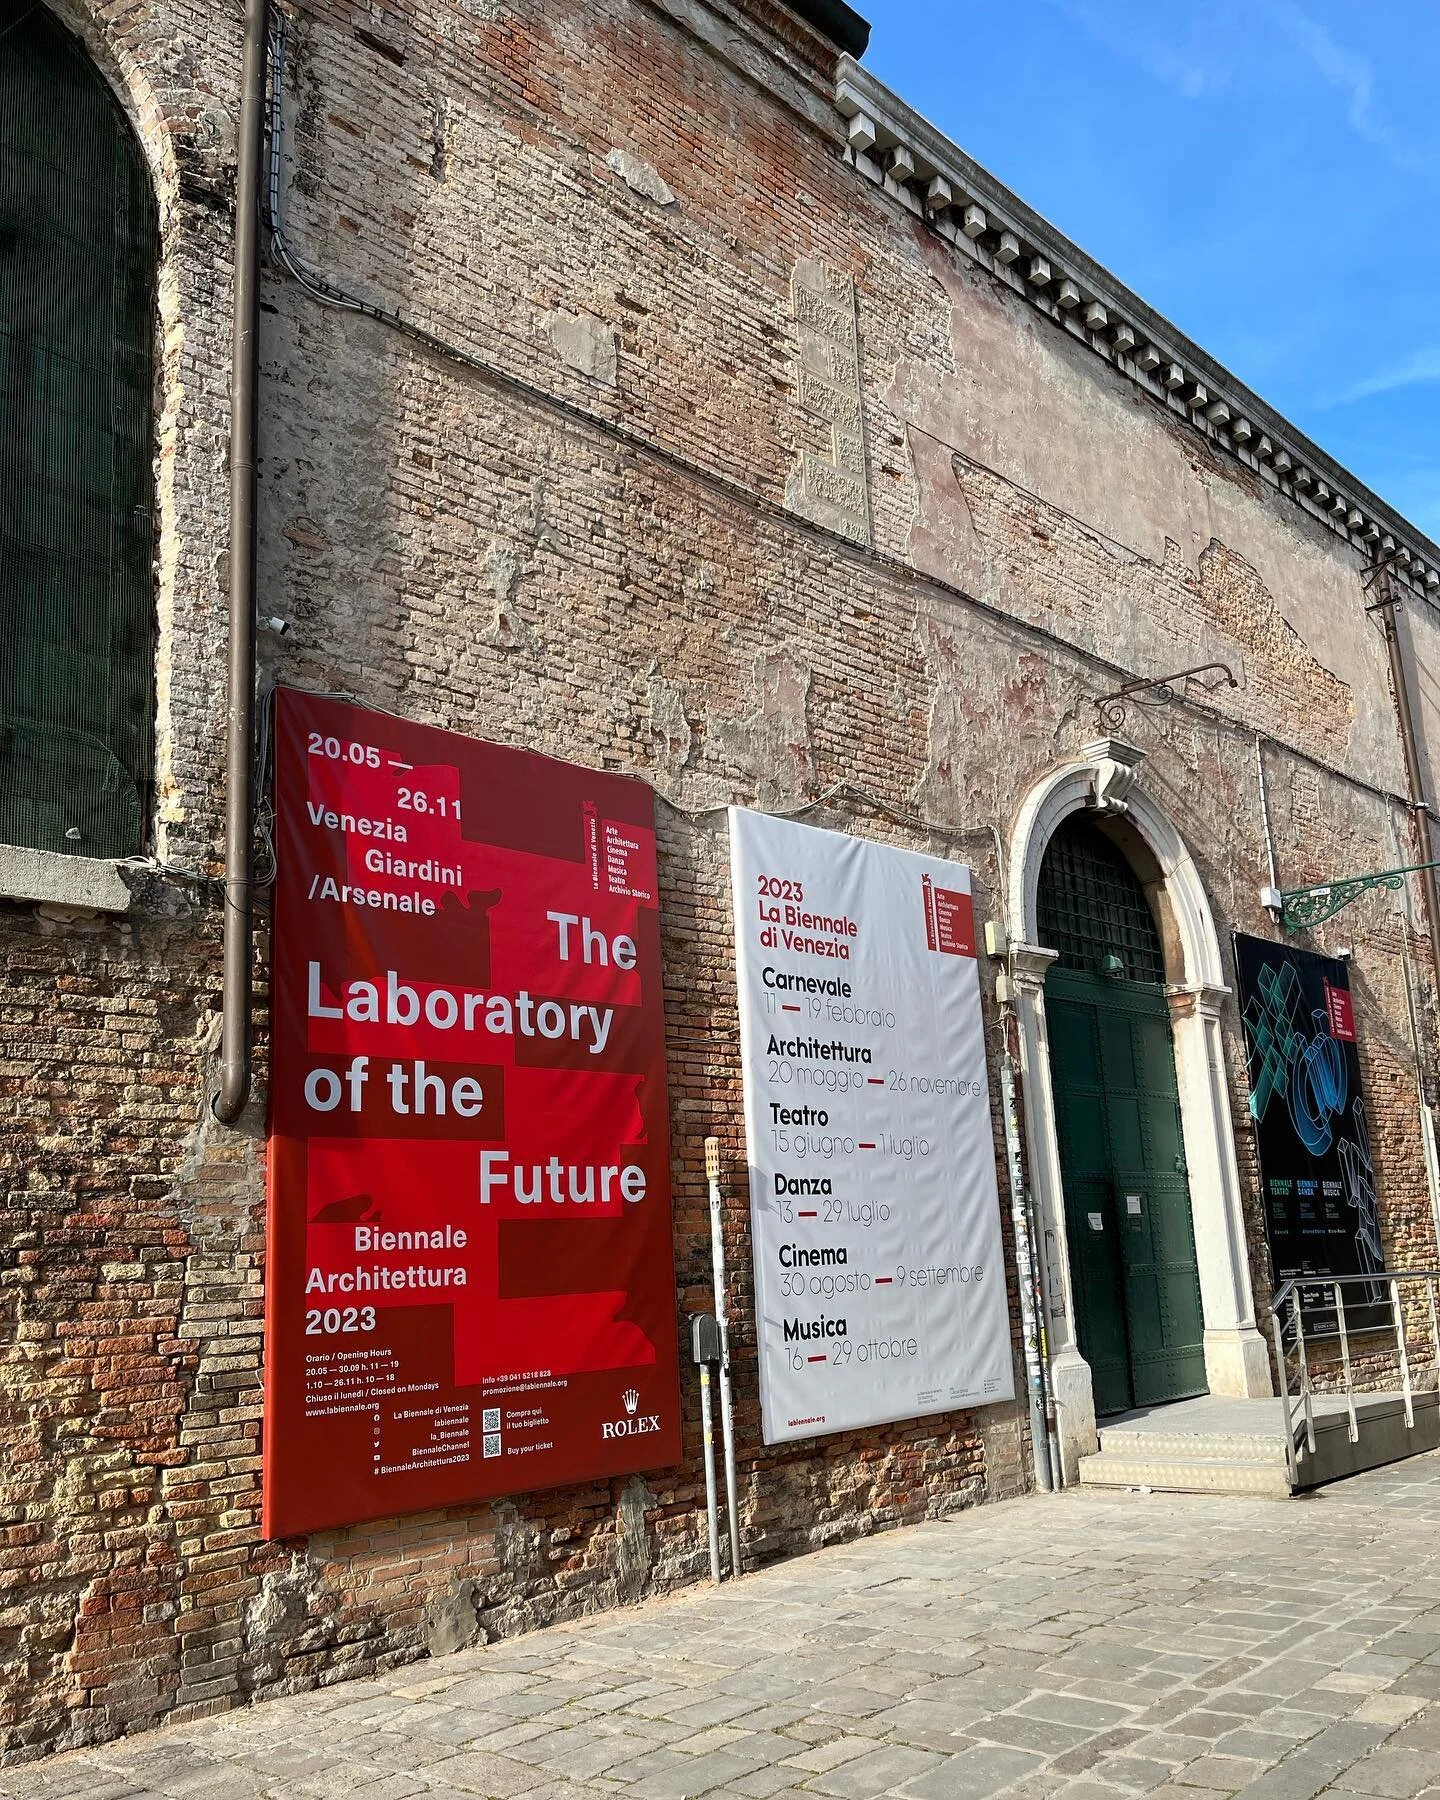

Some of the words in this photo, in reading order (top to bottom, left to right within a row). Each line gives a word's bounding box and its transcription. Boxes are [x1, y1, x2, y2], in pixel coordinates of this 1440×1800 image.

[308, 732, 381, 768] 20.05
[397, 787, 461, 820] 26.11
[306, 801, 408, 843] Venezia
[606, 826, 618, 836] Arte
[607, 835, 639, 850] Architettura
[607, 845, 628, 857] Cinema
[365, 849, 462, 887] Giardini
[607, 855, 625, 866] Danza
[607, 865, 627, 876] Musica
[608, 875, 626, 885] Teatro
[608, 885, 632, 896] Archivio
[632, 889, 650, 900] Storico
[757, 875, 804, 903] 2023
[307, 874, 436, 916] /Arsenale
[759, 900, 781, 924] La
[785, 905, 858, 937] Biennale
[546, 910, 638, 970] The
[760, 926, 778, 948] di
[781, 928, 850, 960] Venezia
[762, 966, 852, 998] Carnevale
[307, 960, 614, 1054] Laboratory
[763, 992, 776, 1015] 11
[805, 997, 822, 1019] 19
[825, 998, 896, 1029] febbraio
[766, 1033, 872, 1064] Architettura
[304, 1056, 369, 1112] of
[386, 1060, 484, 1118] the
[768, 1060, 792, 1084] 20
[797, 1066, 864, 1093] maggio
[888, 1069, 907, 1092] 26
[911, 1076, 981, 1097] novembre
[769, 1102, 829, 1127] Teatro
[771, 1129, 790, 1153] 15
[793, 1132, 855, 1160] giugno
[879, 1133, 886, 1155] 1
[890, 1133, 930, 1161] luglio
[479, 1150, 647, 1205] Future
[774, 1172, 832, 1196] Danza
[775, 1200, 794, 1224] 13
[822, 1199, 843, 1223] 29
[847, 1201, 890, 1228] luglio
[355, 1224, 467, 1252] Biennale
[778, 1243, 848, 1268] Cinema
[305, 1265, 467, 1294] Architettura
[780, 1271, 805, 1297] 30
[809, 1270, 871, 1300] agosto
[896, 1265, 905, 1288] 9
[909, 1263, 984, 1288] settembre
[305, 1305, 376, 1336] 2023
[783, 1314, 847, 1342] Musica
[305, 1354, 330, 1363] Orario
[331, 1353, 336, 1361] /
[337, 1350, 369, 1360] Opening
[369, 1349, 392, 1357] Hours
[785, 1346, 804, 1372] 16
[832, 1340, 852, 1366] 29
[857, 1336, 918, 1362] ottobre
[305, 1366, 328, 1376] 20.05
[338, 1364, 360, 1373] 30.09
[361, 1363, 369, 1371] h.
[370, 1362, 379, 1370] 11
[390, 1360, 399, 1368] 19
[482, 1376, 496, 1385] Info
[509, 1373, 521, 1381] 041
[522, 1371, 538, 1380] 5218
[305, 1395, 333, 1404] Chiuso
[365, 1389, 369, 1397] /
[370, 1386, 396, 1396] Closed
[407, 1382, 439, 1392] Mondays
[306, 1381, 323, 1390] 1.10
[334, 1377, 355, 1387] 26.11
[365, 1376, 375, 1384] 10
[482, 1379, 568, 1397] promozione@labiennale.org
[305, 1402, 380, 1417] www.labiennale.org
[393, 1412, 402, 1420] La
[403, 1407, 434, 1418] Biennale
[435, 1406, 442, 1414] di
[442, 1403, 469, 1413] Venezia
[434, 1416, 469, 1427] labiennale
[506, 1409, 531, 1419] Compra
[531, 1406, 543, 1416] qui
[788, 1415, 826, 1427] labiennale.org
[430, 1428, 470, 1441] la_Biennale
[506, 1422, 511, 1430] il
[511, 1421, 523, 1429] tuo
[523, 1418, 550, 1428] biglietto
[601, 1415, 661, 1439] ROLEX
[412, 1441, 470, 1456] BiennaleChannel
[507, 1447, 520, 1455] Buy
[520, 1445, 535, 1454] your
[535, 1441, 553, 1450] ticket
